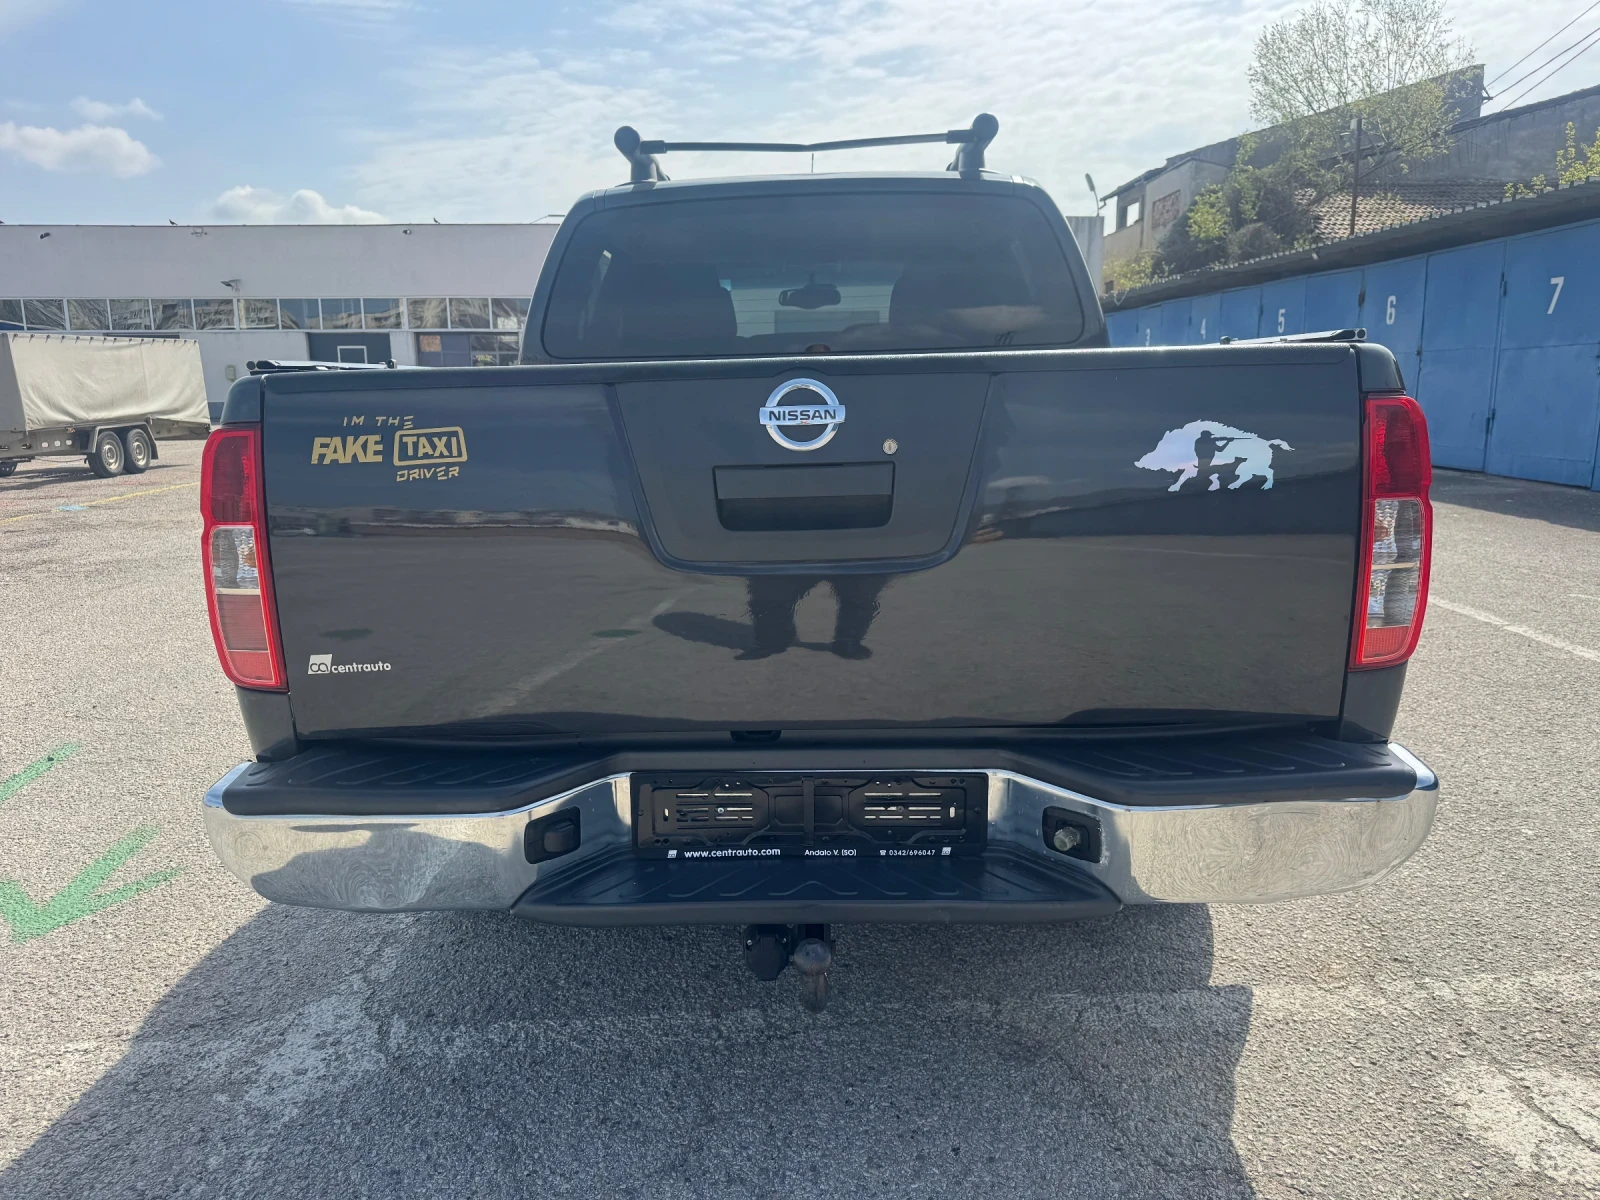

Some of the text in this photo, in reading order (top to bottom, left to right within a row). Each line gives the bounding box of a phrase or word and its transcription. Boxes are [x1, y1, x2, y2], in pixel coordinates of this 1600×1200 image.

[1547, 276, 1565, 314] 7
[1385, 295, 1396, 325] 6
[1200, 318, 1207, 340] 4
[1277, 309, 1286, 333] 5
[1145, 328, 1151, 347] 3
[375, 415, 414, 430] THE
[768, 408, 837, 422] NISSAN
[310, 434, 458, 465] FAKE TAXI
[396, 466, 460, 482] DRIVER
[331, 660, 392, 673] centrauto
[684, 848, 781, 858] www.centrauto.com
